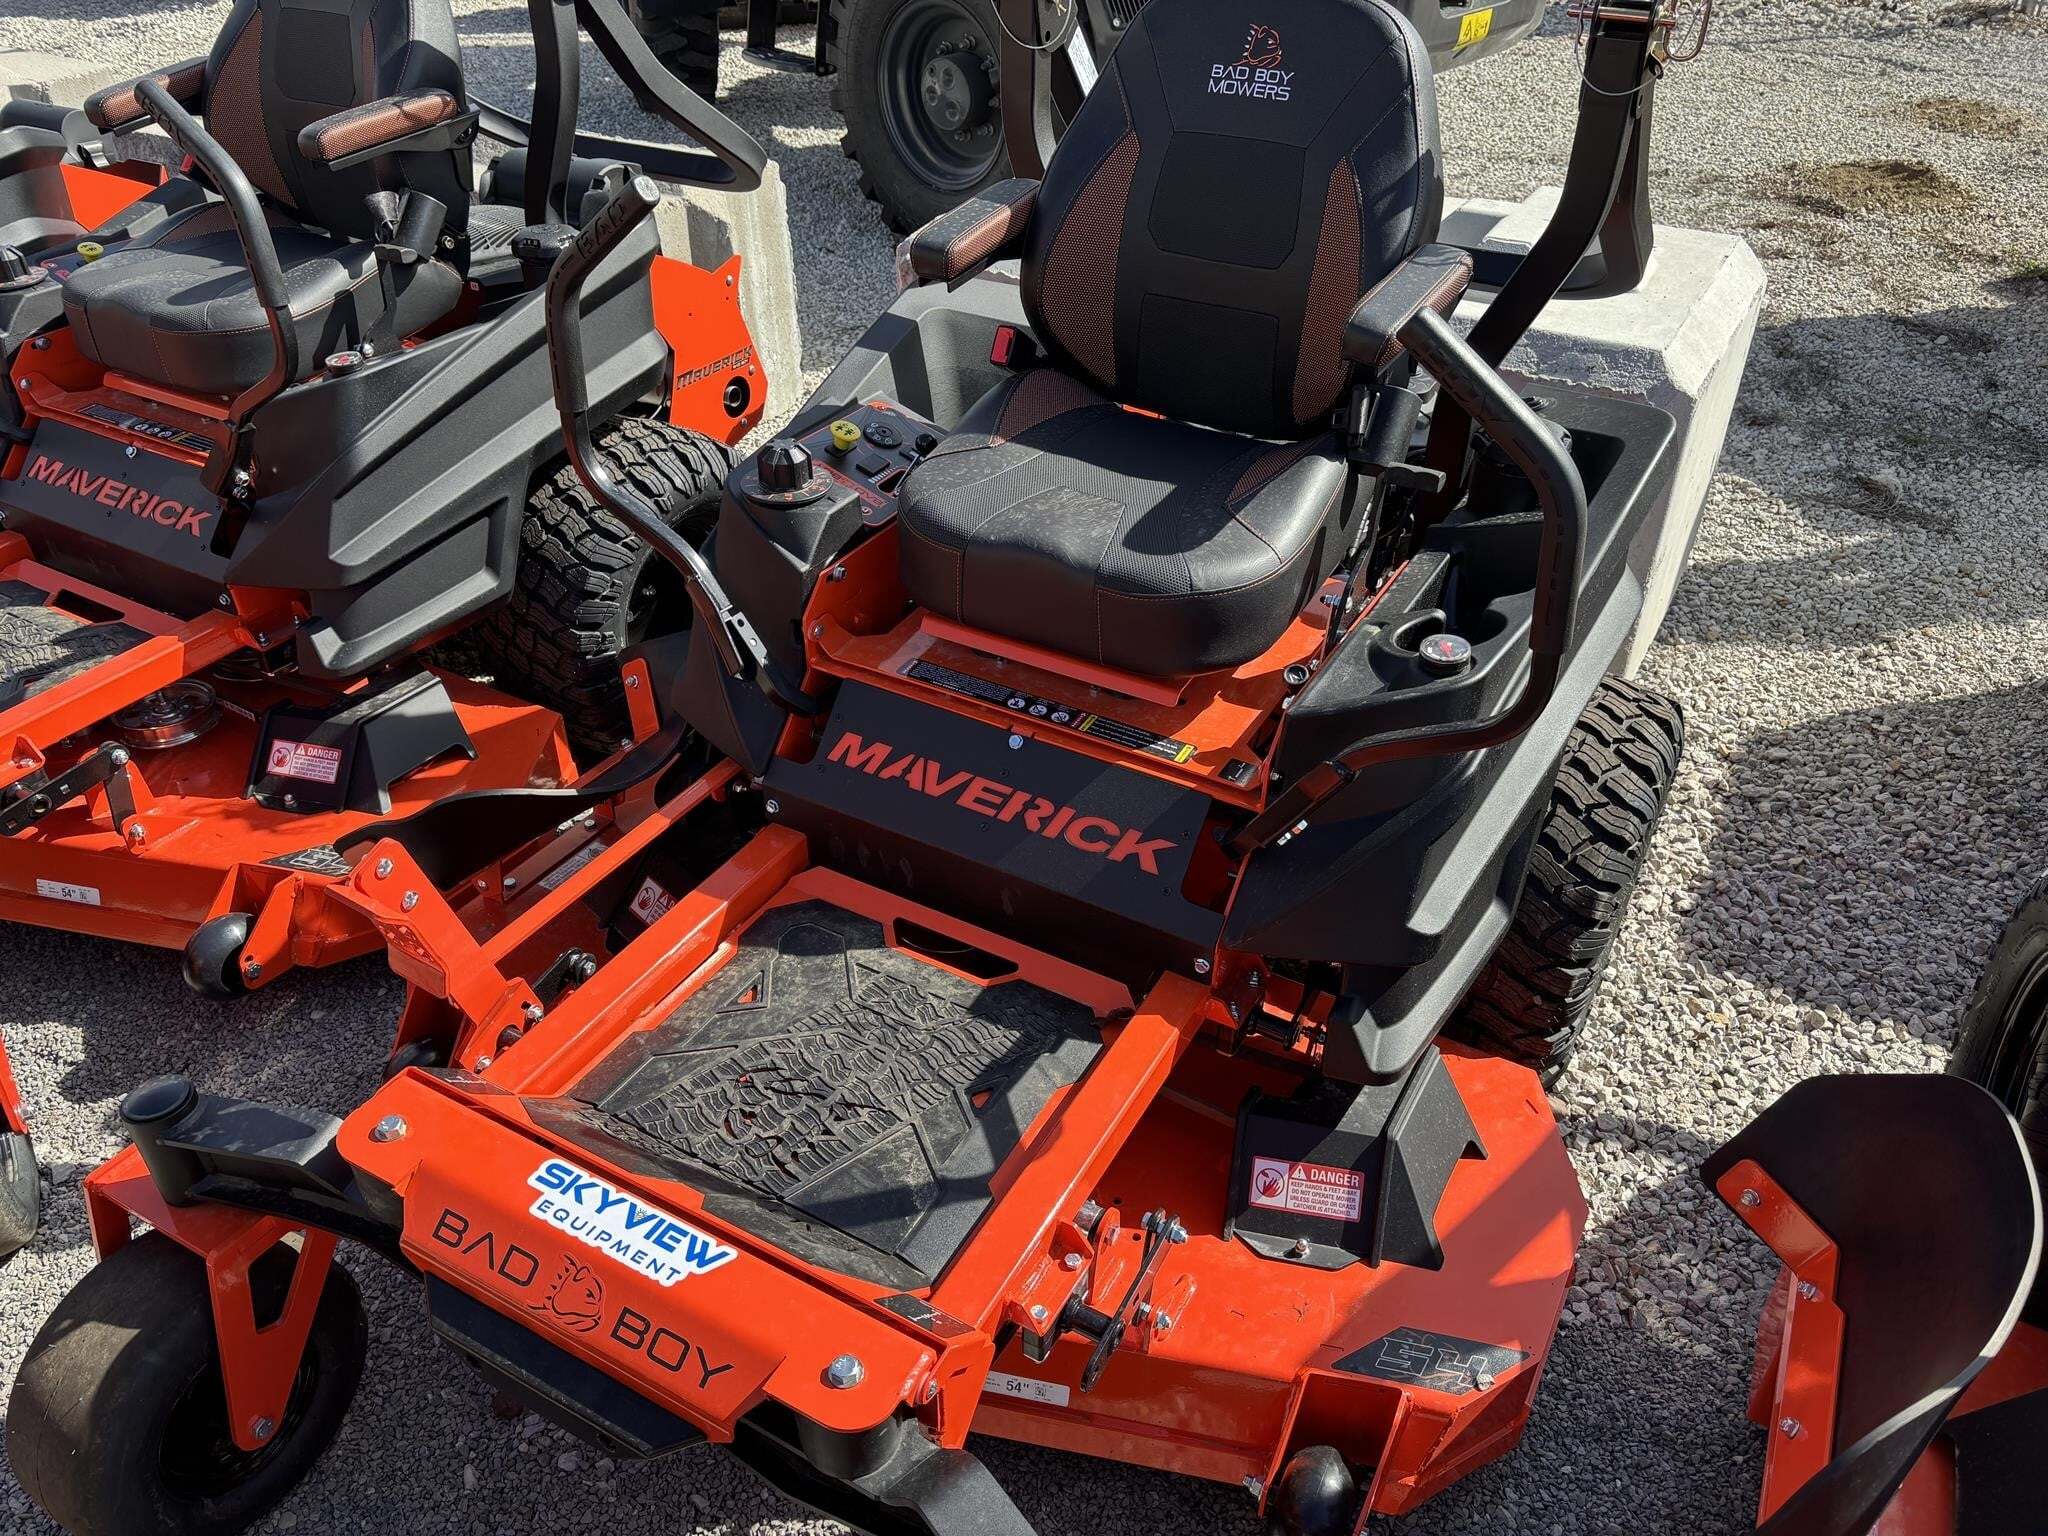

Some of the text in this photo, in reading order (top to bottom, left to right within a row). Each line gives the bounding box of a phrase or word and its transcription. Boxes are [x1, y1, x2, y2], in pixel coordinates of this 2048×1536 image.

[1207, 78, 1291, 101] MOWERS
[1211, 64, 1295, 85] BAD BOY
[27, 455, 213, 538] MAVERICK
[307, 747, 339, 760] DANGER
[828, 731, 1181, 876] MAVERICK
[535, 1162, 731, 1269] SKYVIEW
[1310, 1168, 1360, 1187] DANGER
[536, 1199, 682, 1281] EQUIPMENT
[432, 1208, 735, 1389] BAD BOY
